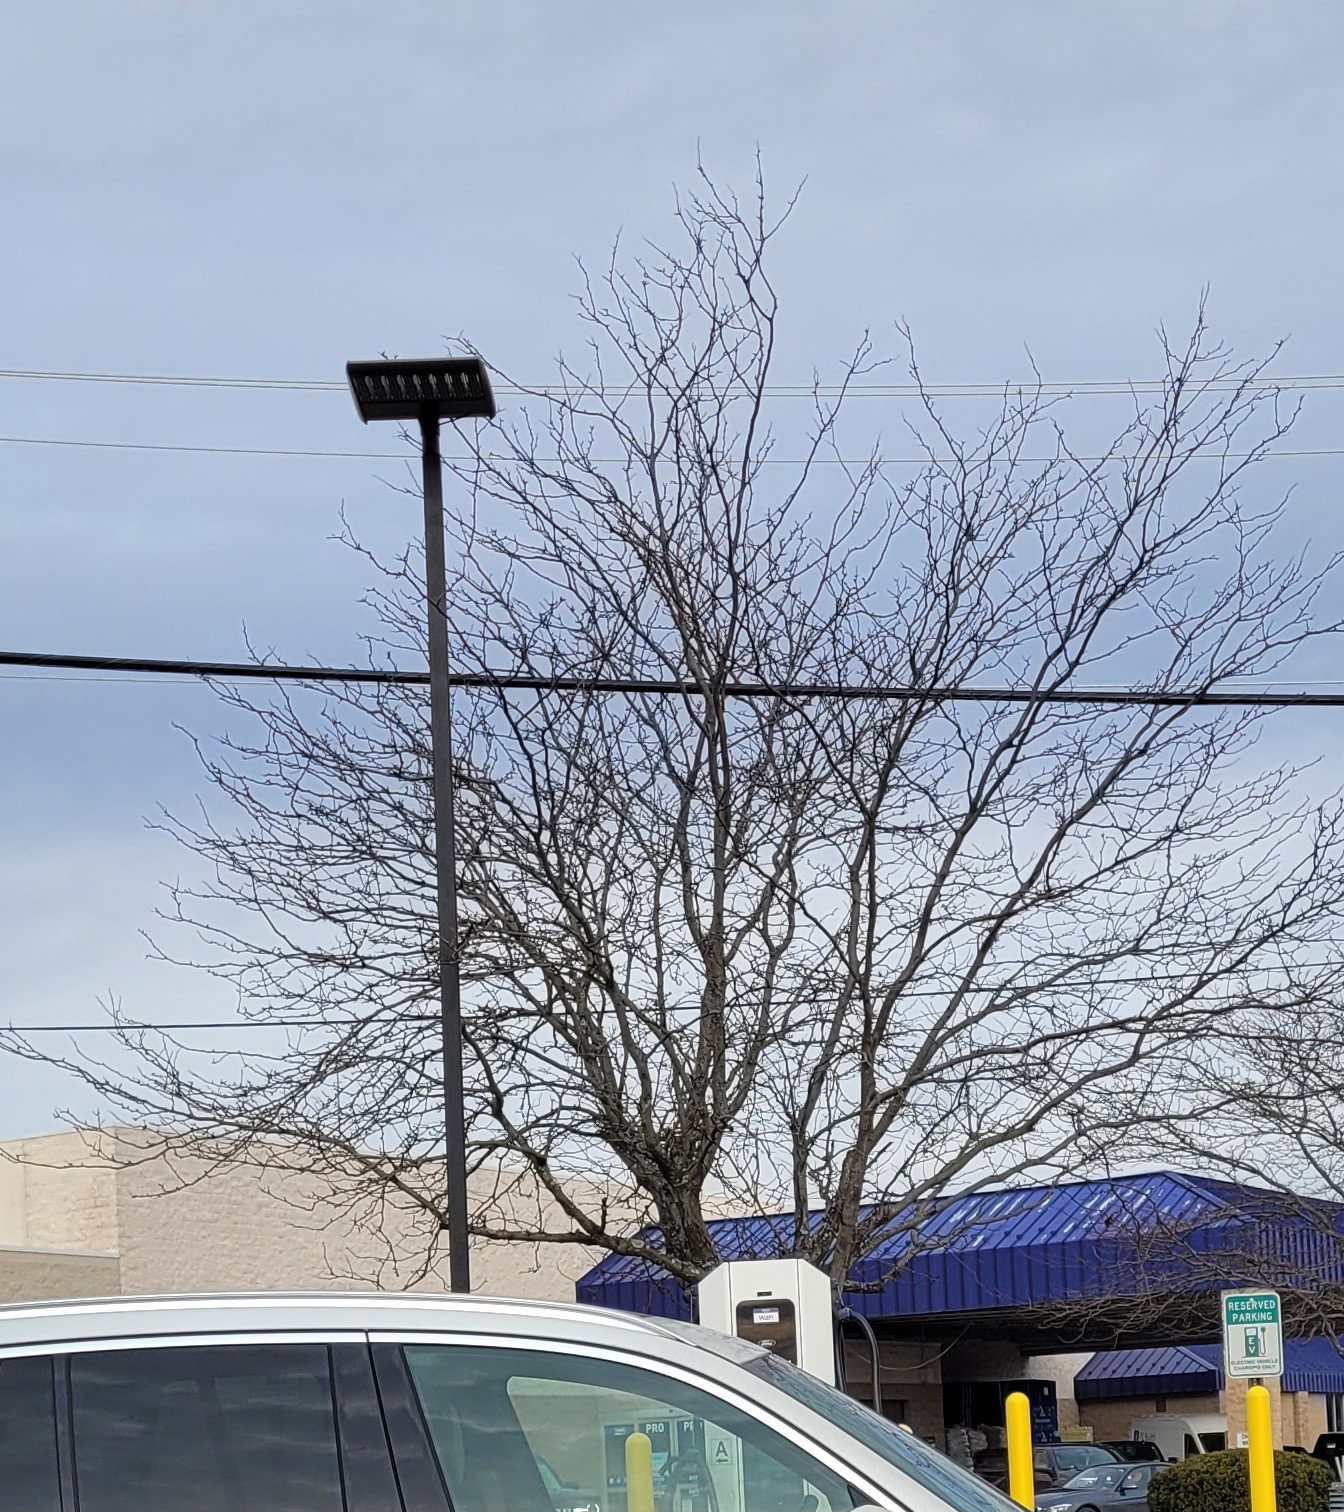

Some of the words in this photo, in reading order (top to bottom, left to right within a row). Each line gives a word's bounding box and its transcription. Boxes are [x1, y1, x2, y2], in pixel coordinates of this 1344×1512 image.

[1228, 1299, 1276, 1311] RESERVED
[1232, 1311, 1273, 1322] PARKING
[645, 1423, 665, 1434] PRO
[716, 1441, 728, 1457] A
